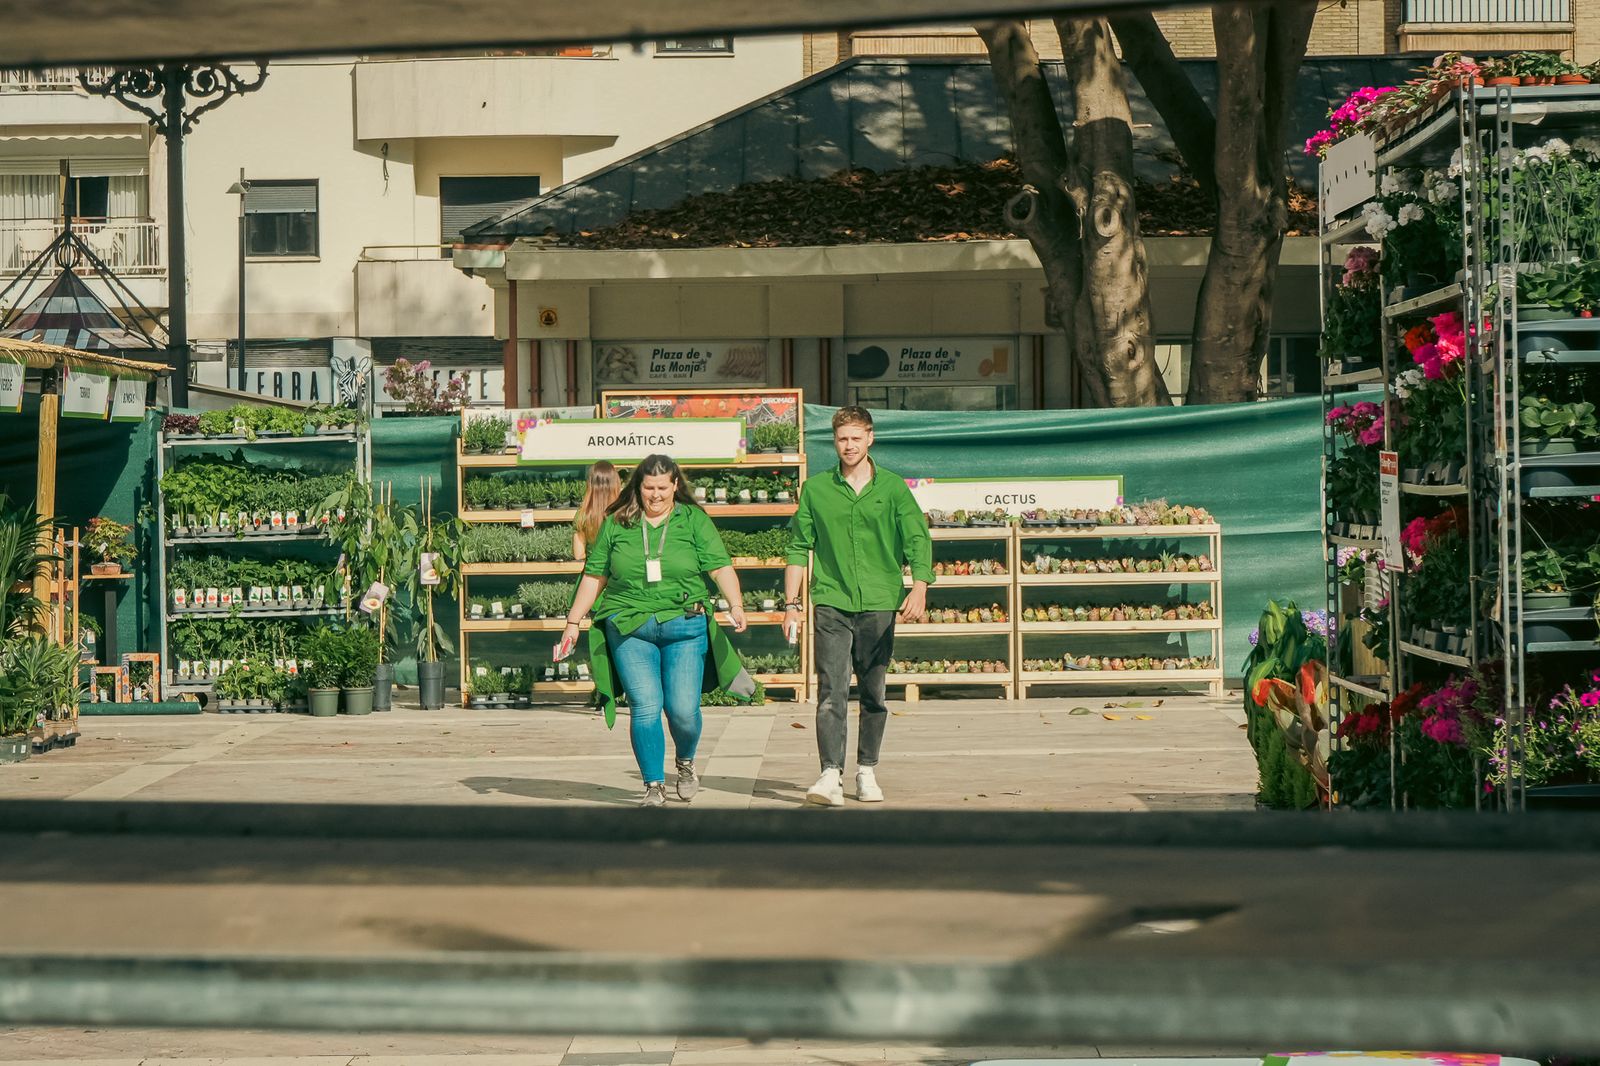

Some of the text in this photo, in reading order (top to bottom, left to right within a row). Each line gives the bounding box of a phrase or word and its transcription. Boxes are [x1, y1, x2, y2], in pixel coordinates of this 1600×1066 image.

[652, 347, 700, 360] Plaza de
[901, 347, 949, 359] Plaza de
[649, 361, 666, 373] Las
[898, 360, 915, 372] Las
[587, 432, 674, 447] AROMÁTICAS
[984, 494, 1036, 505] CACTUS
